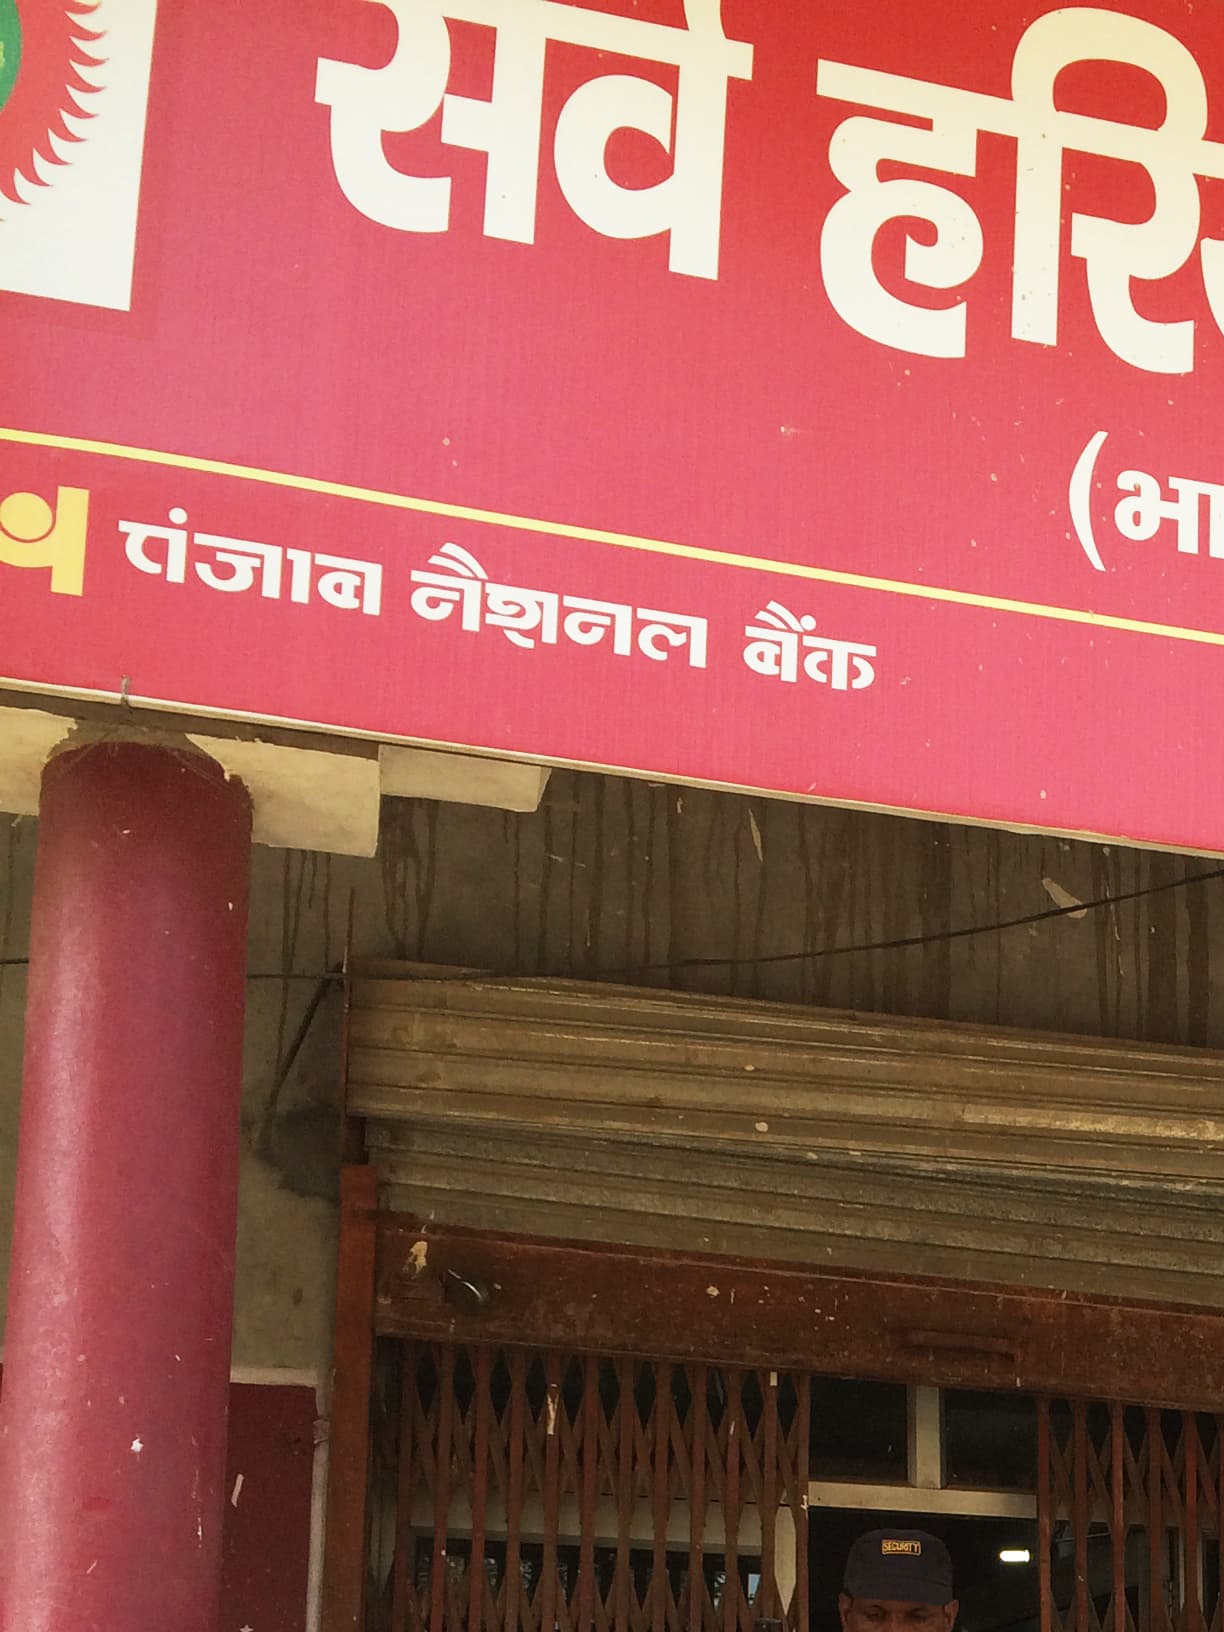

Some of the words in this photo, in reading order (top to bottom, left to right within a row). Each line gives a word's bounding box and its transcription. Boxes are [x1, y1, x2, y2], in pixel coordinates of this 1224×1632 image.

[118, 507, 383, 616] पंजाब
[411, 542, 708, 668] नैशनल
[743, 600, 877, 692] बैंक
[883, 1542, 919, 1553] SECURITY
